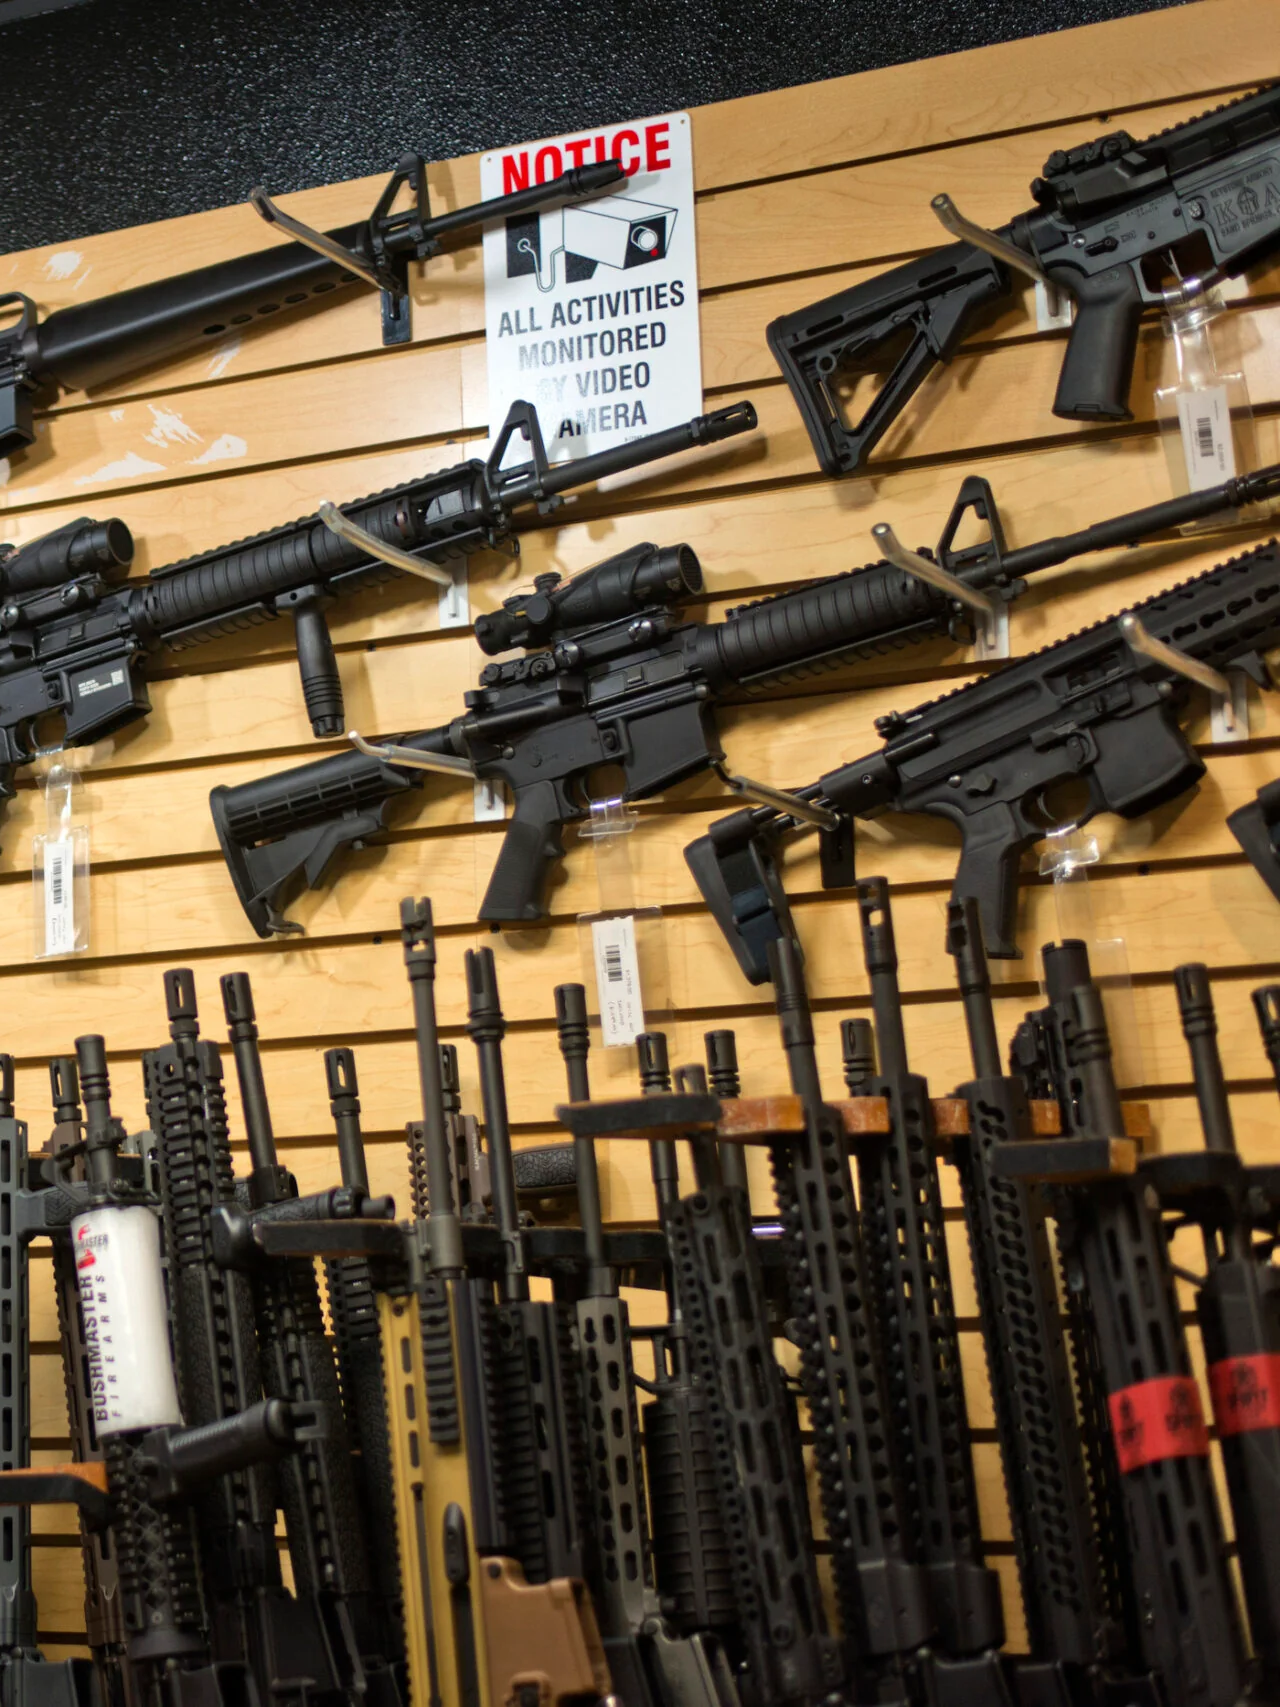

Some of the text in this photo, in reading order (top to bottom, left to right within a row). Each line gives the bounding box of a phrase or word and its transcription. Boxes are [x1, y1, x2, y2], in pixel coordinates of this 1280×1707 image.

[502, 122, 671, 195] NOTICE
[498, 280, 685, 337] ALL ACTIVITIES
[518, 321, 666, 371] MONITORED
[576, 361, 650, 398] VIDEO
[79, 1275, 109, 1422] BUSHMASTER
